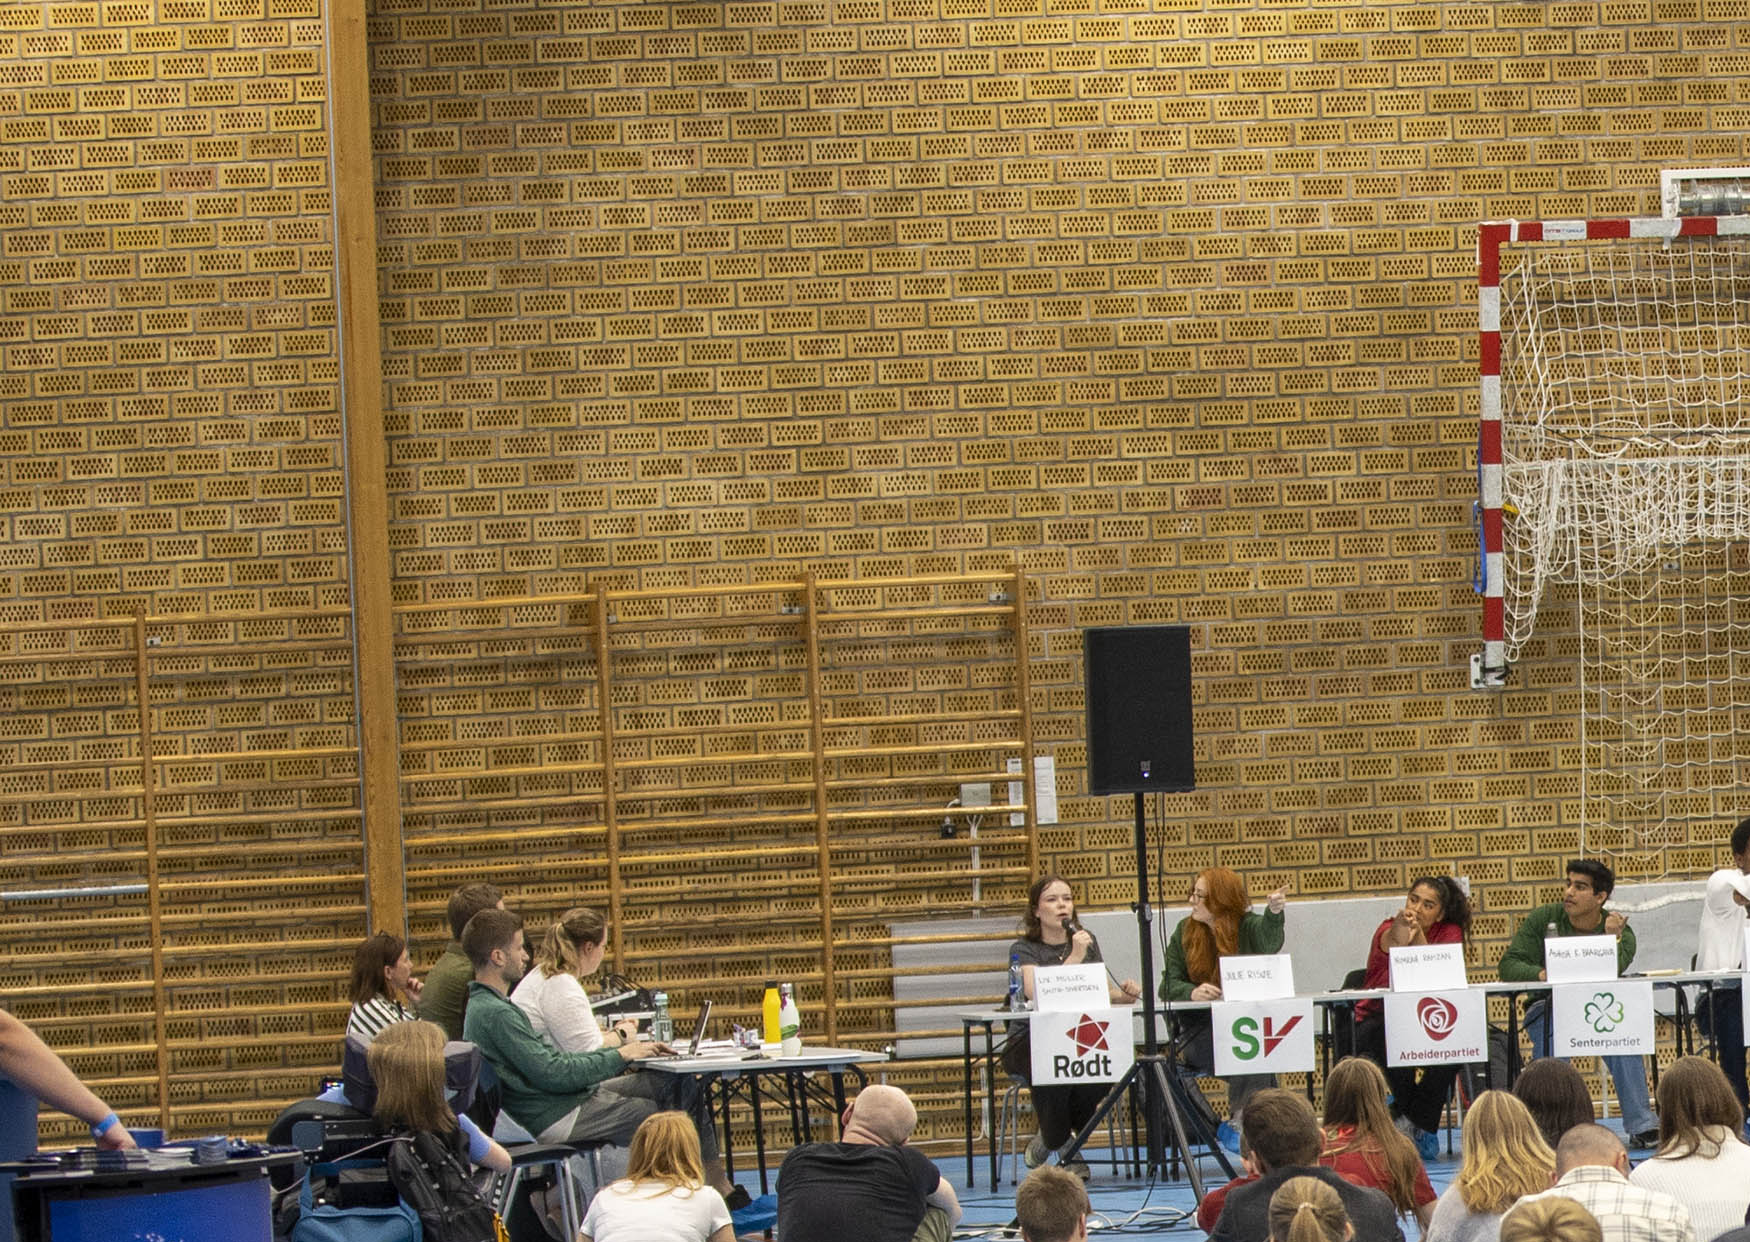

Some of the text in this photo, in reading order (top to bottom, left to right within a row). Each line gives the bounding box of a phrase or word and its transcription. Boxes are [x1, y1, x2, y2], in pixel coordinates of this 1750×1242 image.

[1231, 1015, 1304, 1061] SV
[1569, 1037, 1641, 1049] Senterpartiet
[1399, 1047, 1480, 1060] Arbeiderpartiet
[1053, 1053, 1112, 1079] Rødt
